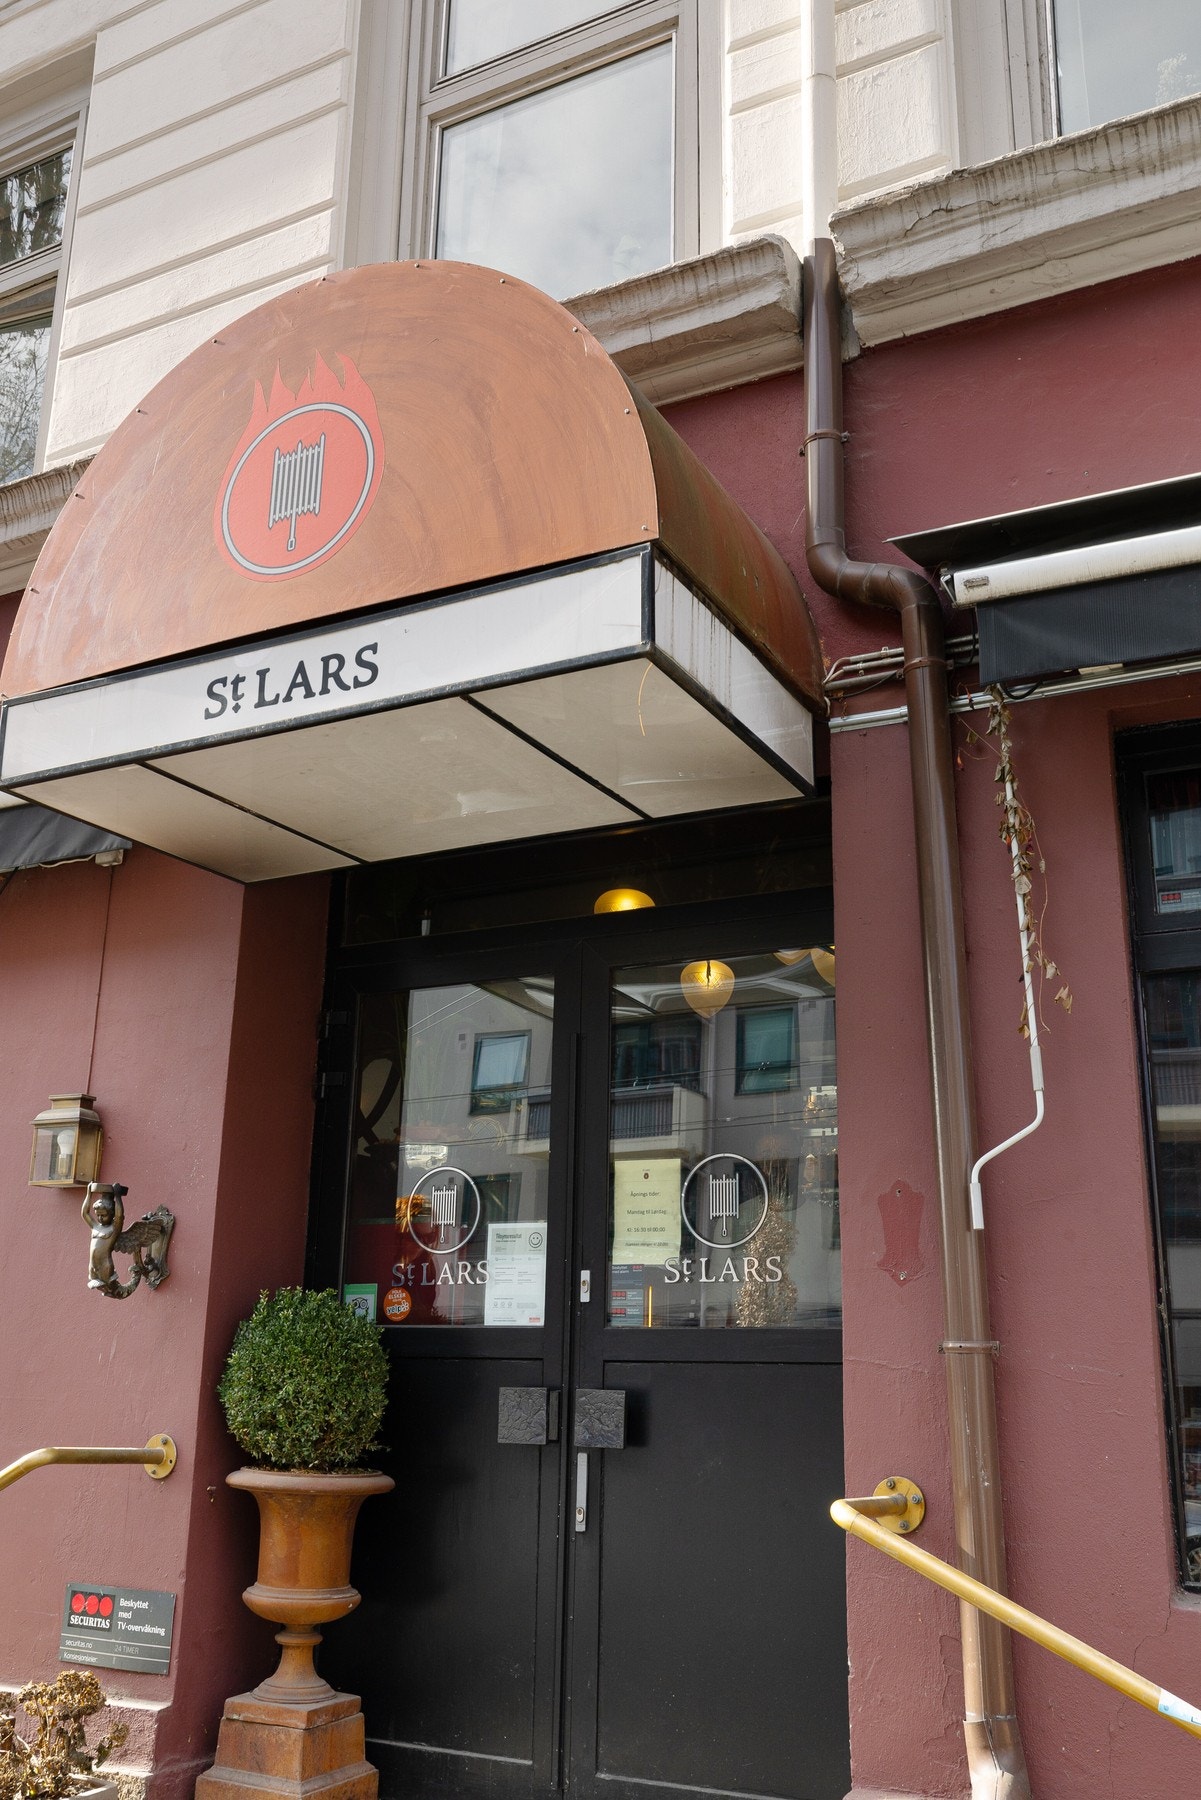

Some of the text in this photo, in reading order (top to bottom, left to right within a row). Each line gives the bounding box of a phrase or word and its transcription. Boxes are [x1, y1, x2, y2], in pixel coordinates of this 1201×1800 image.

[254, 642, 379, 709] LARS
[420, 1260, 490, 1286] LARS
[699, 1256, 783, 1283] LARS
[119, 1598, 149, 1609] Beskyttet
[70, 1614, 110, 1629] SECURITAS
[118, 1611, 132, 1619] med
[117, 1621, 166, 1637] TV-overvåkning
[65, 1639, 93, 1649] securitas.no
[114, 1644, 140, 1655] 24 TIMER
